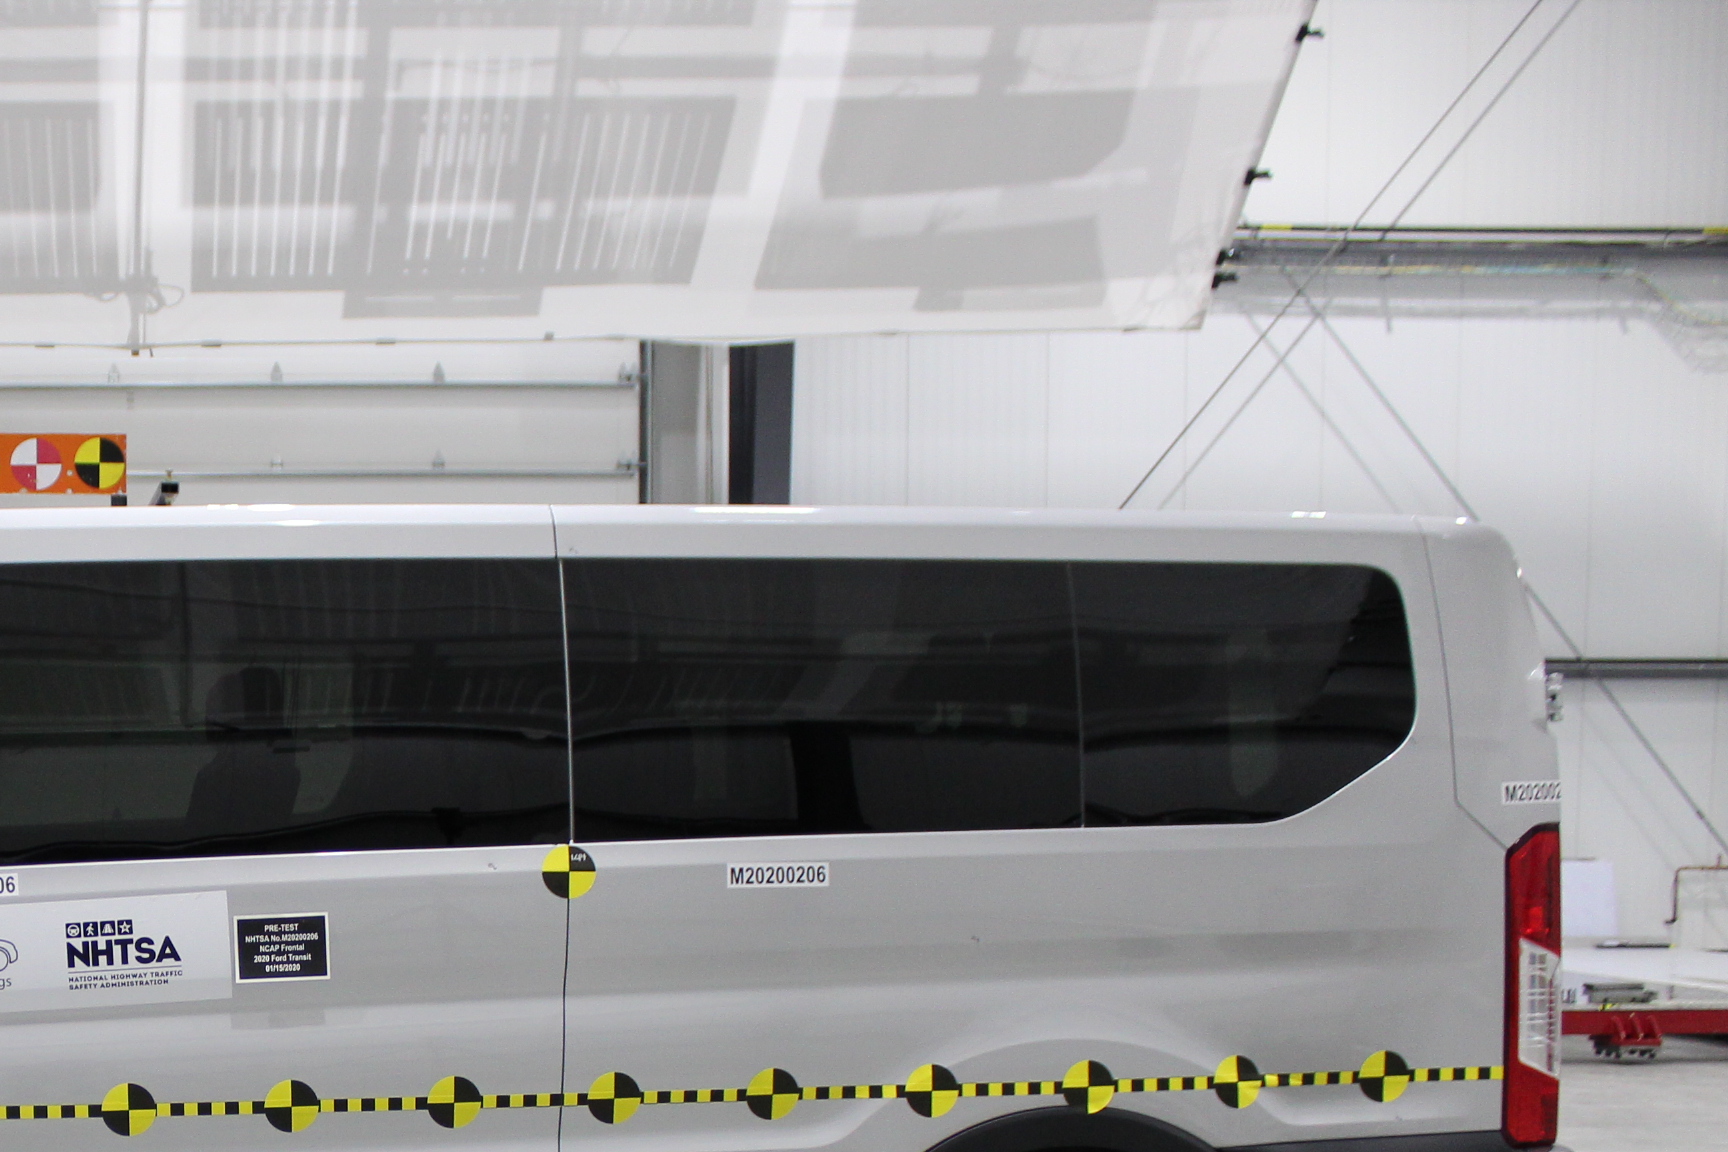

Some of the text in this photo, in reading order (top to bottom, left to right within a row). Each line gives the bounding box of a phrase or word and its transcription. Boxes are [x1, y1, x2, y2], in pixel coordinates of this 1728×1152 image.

[730, 865, 826, 885] M20200206
[264, 923, 299, 932] PRE-TEST
[245, 934, 270, 943] NHTSA
[66, 935, 182, 968] NHTSA
[259, 943, 305, 953] NCAP Frontal
[253, 953, 312, 963] 2020 Ford Transit
[265, 963, 301, 973] 01/15/2020
[68, 974, 108, 983] NATIONAL
[110, 972, 148, 980] HIGHWAY
[69, 979, 169, 990] SAFETY ADMINISTRATION
